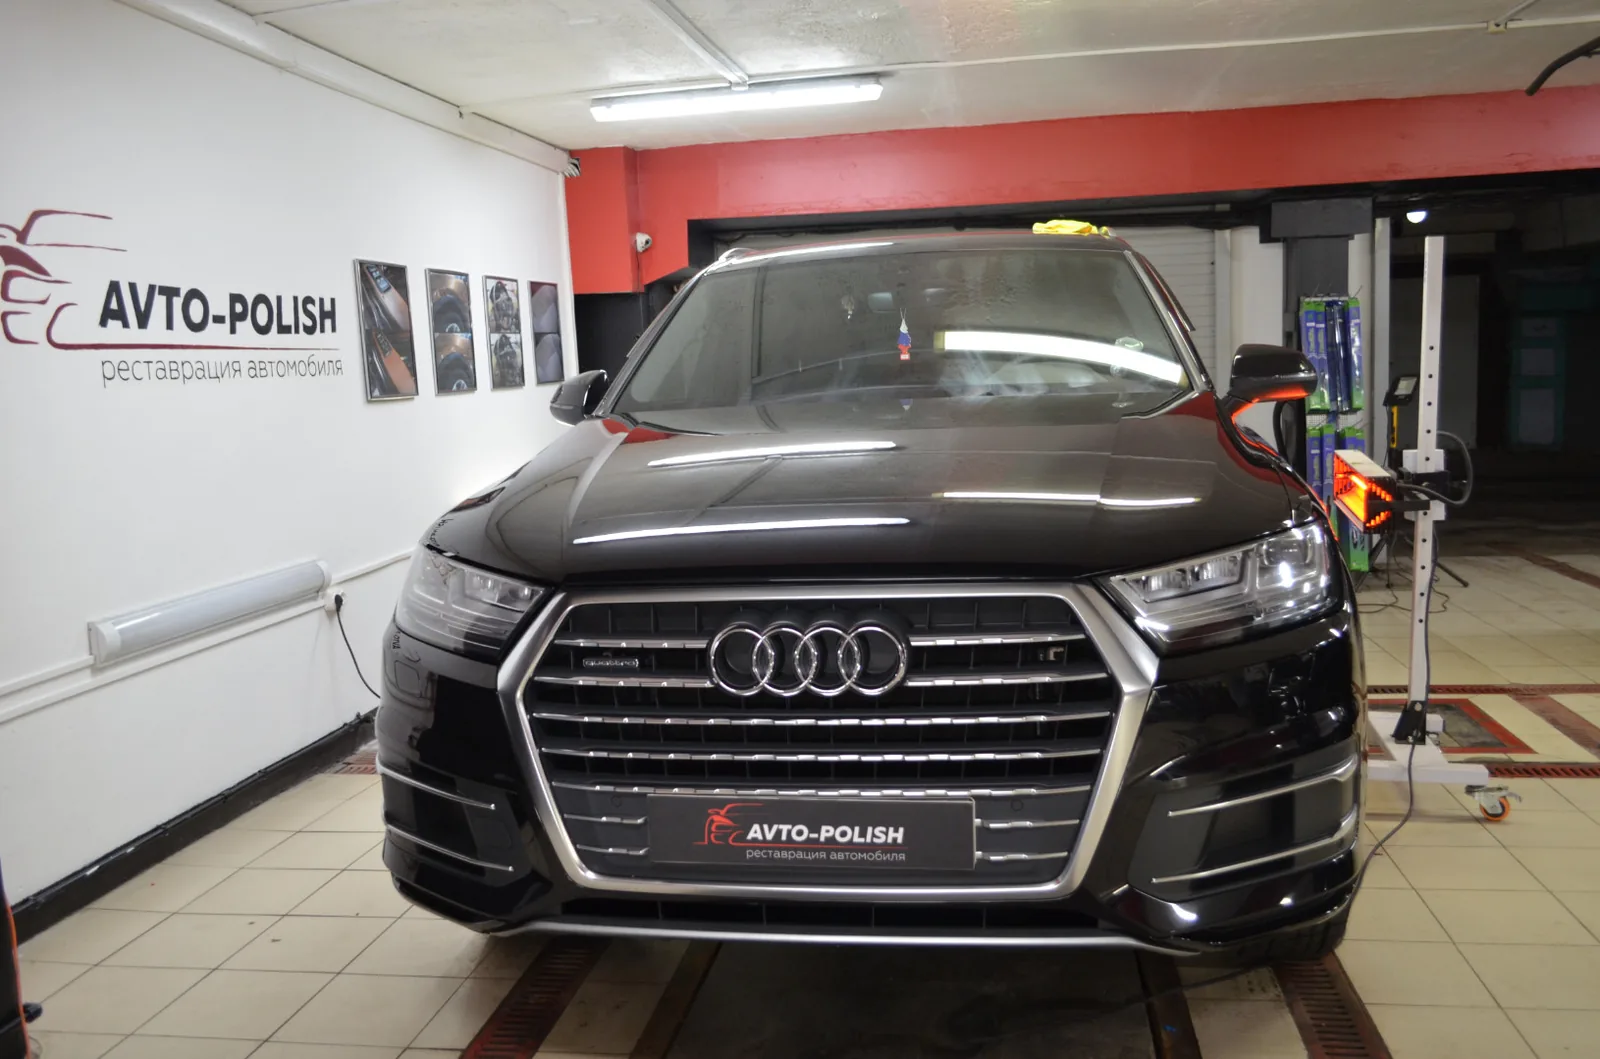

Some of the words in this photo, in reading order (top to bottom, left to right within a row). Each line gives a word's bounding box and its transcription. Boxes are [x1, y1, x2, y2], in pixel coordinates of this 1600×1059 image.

[99, 280, 337, 335] AVTO-POLISH
[101, 359, 242, 388] реставрация
[248, 354, 344, 377] автомобиля
[746, 823, 904, 844] AVTO-POLISH
[746, 849, 826, 860] реставрация
[829, 851, 906, 861] автомобиля
